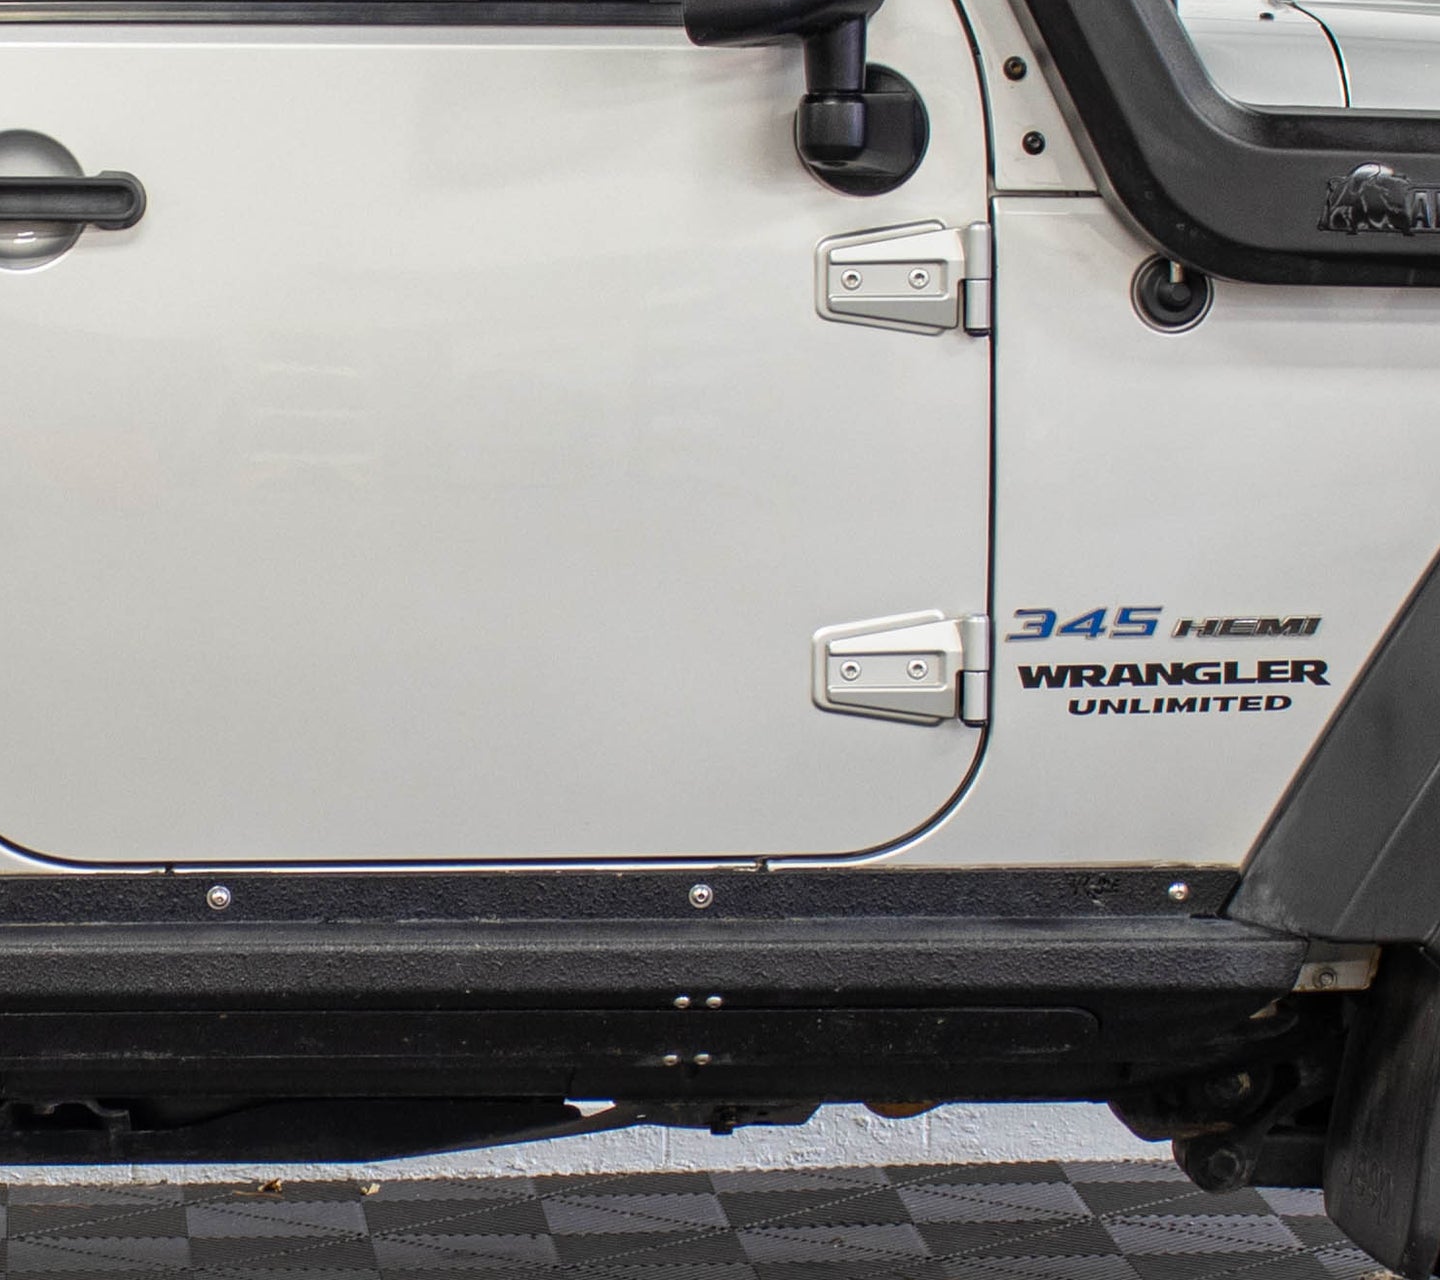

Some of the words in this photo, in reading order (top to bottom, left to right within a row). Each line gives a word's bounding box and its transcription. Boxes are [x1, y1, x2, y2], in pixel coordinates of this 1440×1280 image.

[1005, 606, 1163, 642] 345
[1171, 616, 1323, 639] HEMI
[1018, 660, 1331, 689] WRANGLER
[1068, 695, 1292, 715] UNLIMITED
